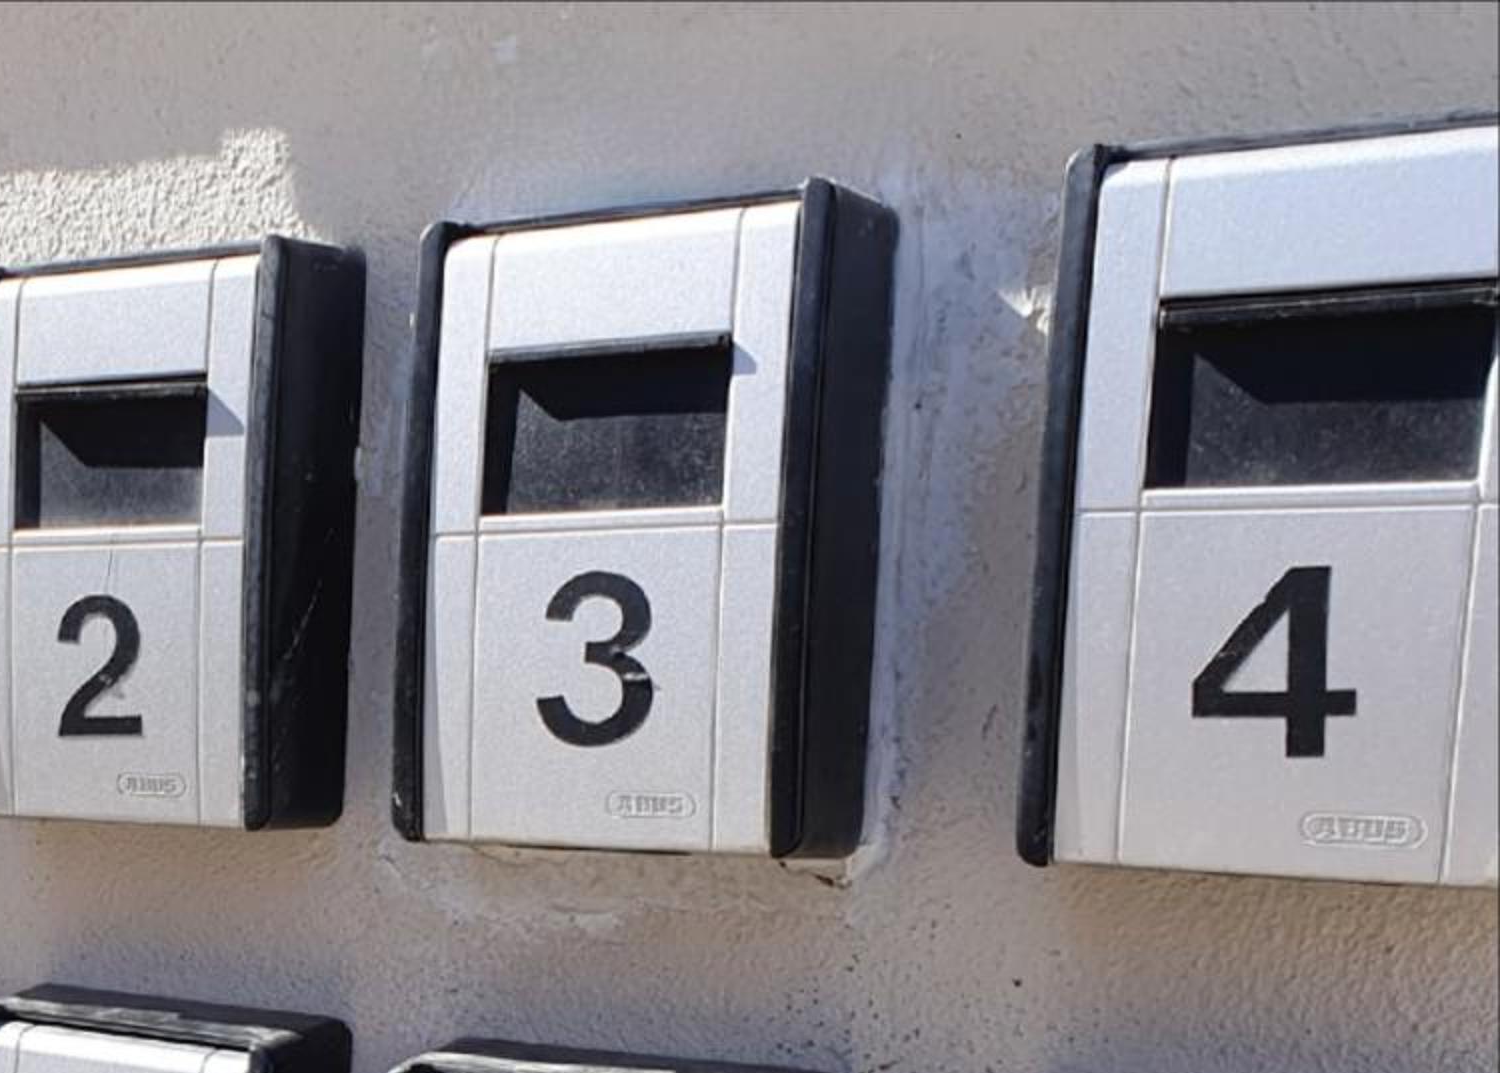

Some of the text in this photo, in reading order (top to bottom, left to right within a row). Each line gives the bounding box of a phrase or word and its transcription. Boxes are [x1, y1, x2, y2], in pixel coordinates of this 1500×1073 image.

[57, 594, 144, 738] 2
[535, 570, 655, 748] 3
[1191, 565, 1358, 759] 4
